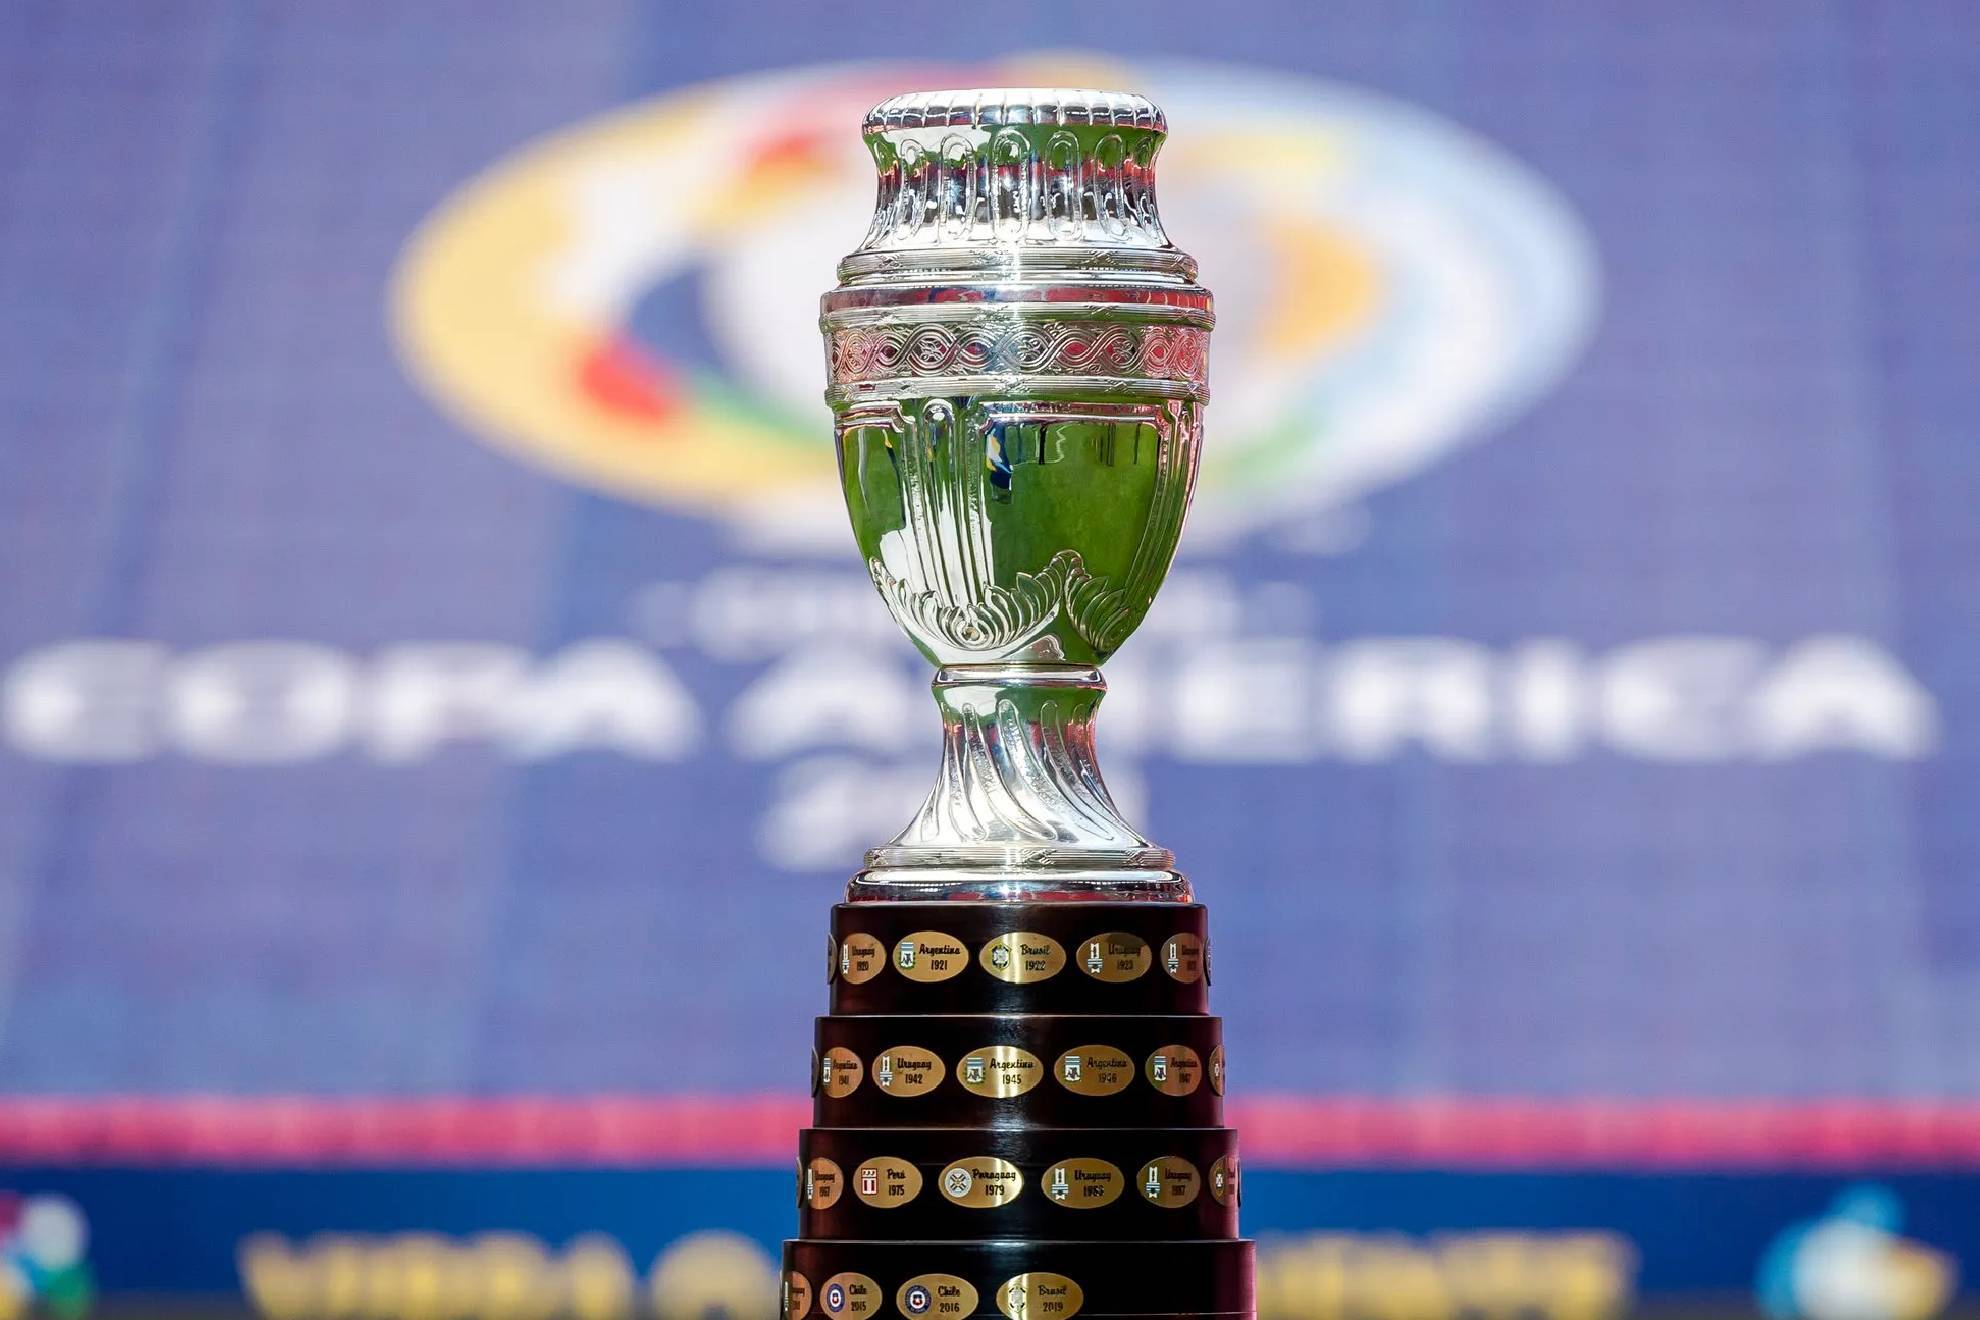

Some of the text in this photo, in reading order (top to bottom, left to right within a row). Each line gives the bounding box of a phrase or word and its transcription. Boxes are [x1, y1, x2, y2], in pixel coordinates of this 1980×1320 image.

[5, 636, 1938, 764] COPA AERICA
[918, 943, 961, 957] Argentina
[931, 959, 948, 970] 1921
[1024, 960, 1047, 972] 1922
[897, 1057, 932, 1071] Uruguay
[989, 1058, 1034, 1071] Argentina
[905, 1073, 923, 1084] 1942
[1002, 1074, 1022, 1085] 1945
[971, 1168, 1016, 1181] Paraguay
[888, 1184, 905, 1196] 1975
[985, 1185, 1005, 1196] 1979
[939, 1302, 961, 1313] 2016
[1043, 1301, 1064, 1313] 2019
